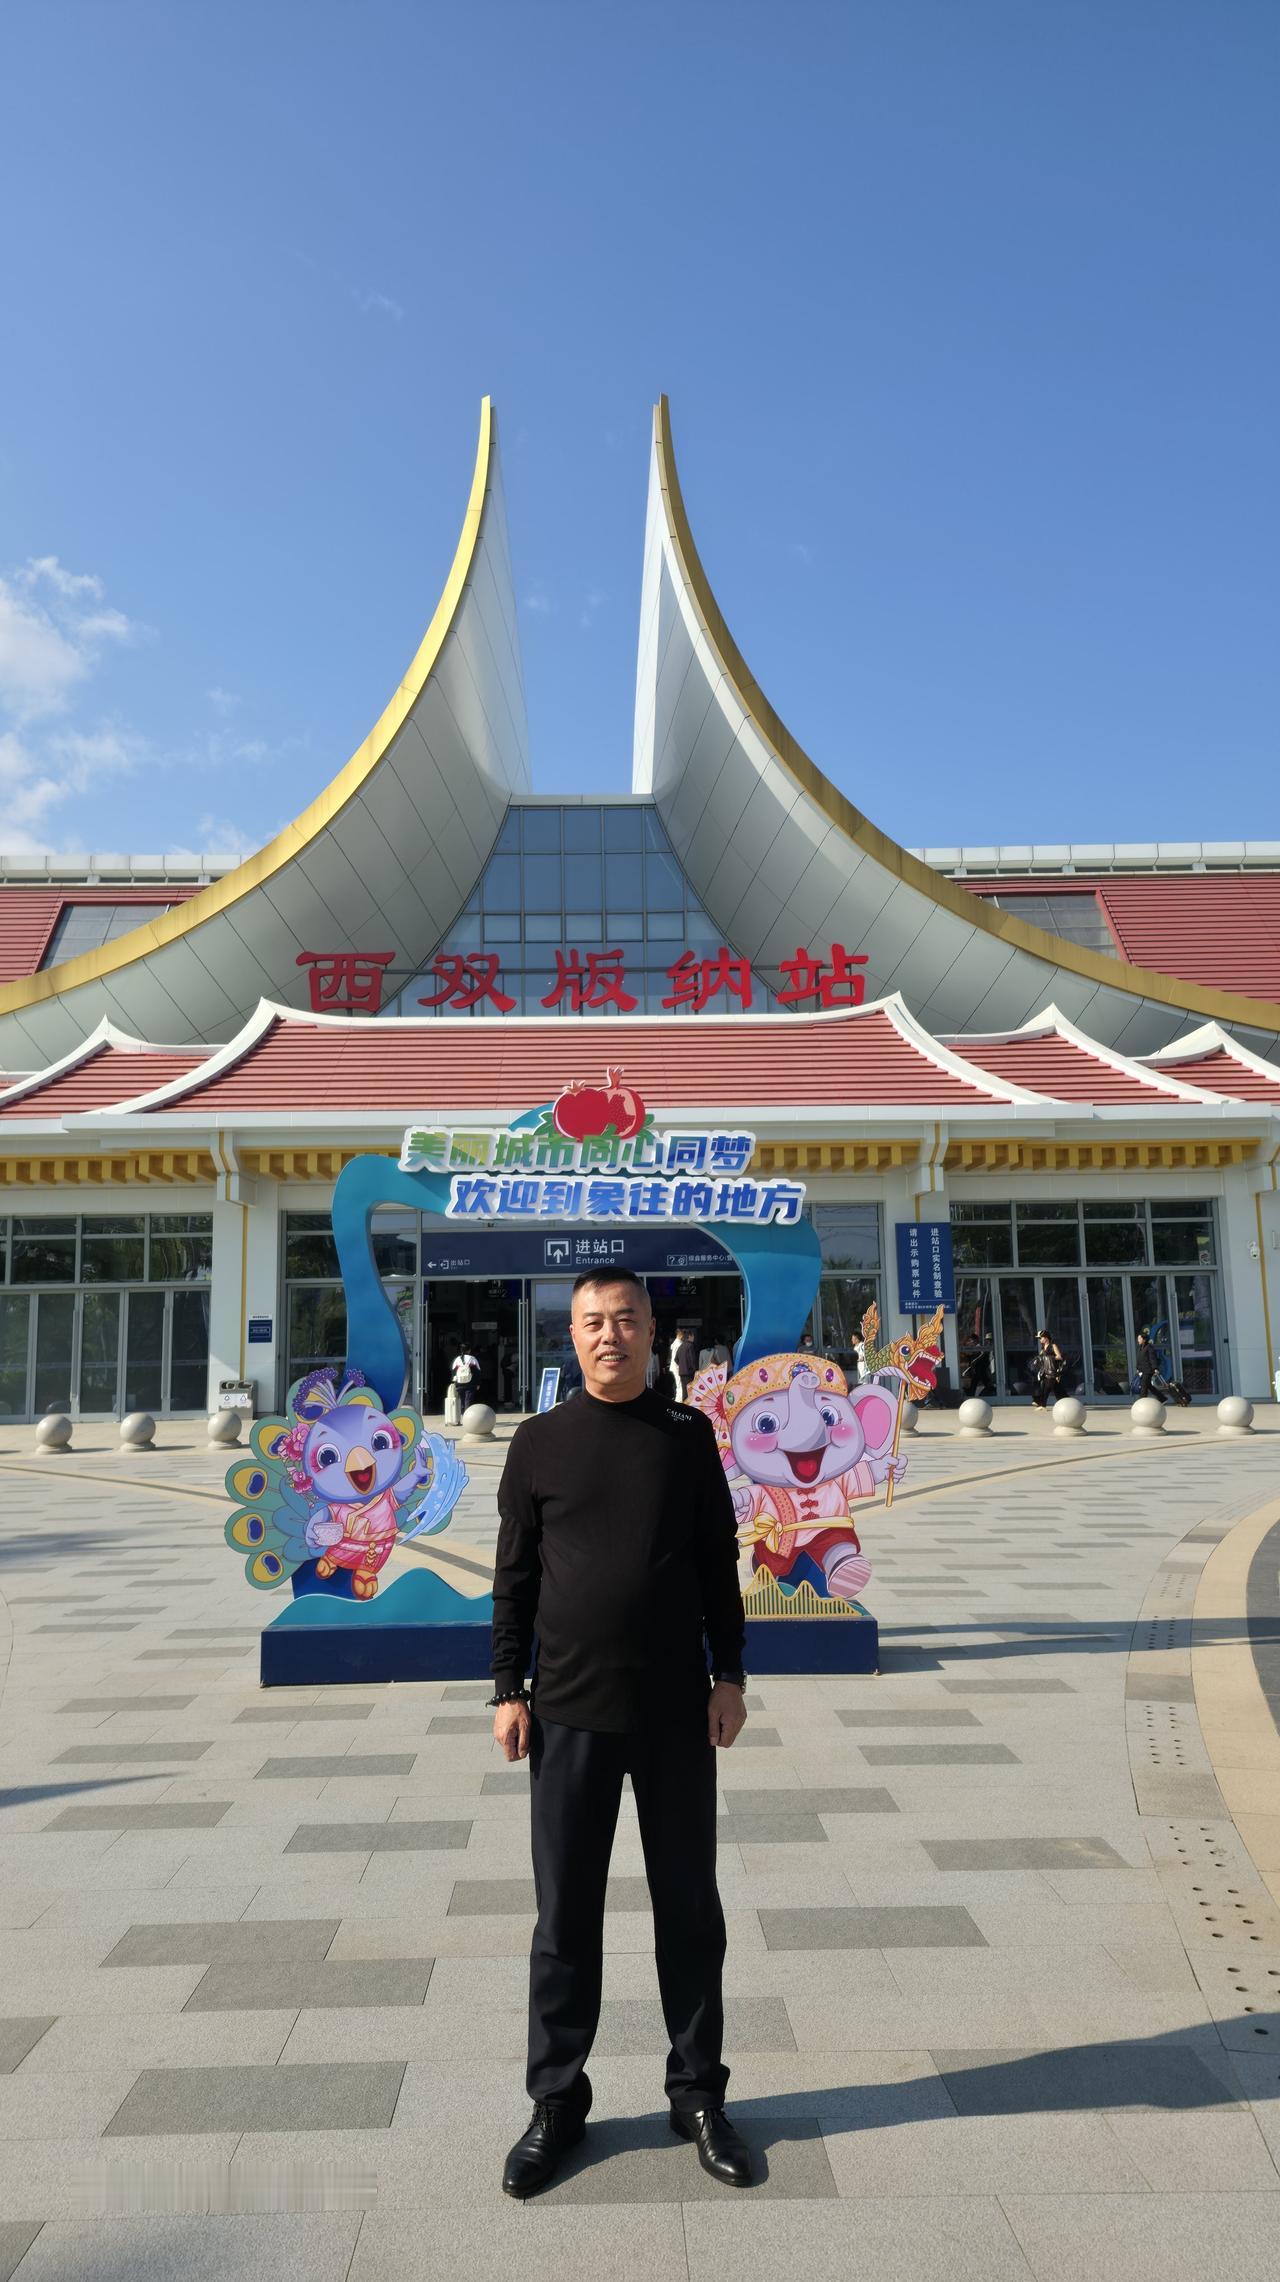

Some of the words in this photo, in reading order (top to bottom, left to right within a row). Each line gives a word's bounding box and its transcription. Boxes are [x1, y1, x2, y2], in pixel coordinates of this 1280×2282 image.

[295, 943, 869, 1013] 西双版纳站
[452, 1178, 801, 1220] 欢迎到象往的地方
[575, 1239, 625, 1254] 进站口
[575, 1255, 615, 1265] Entrance
